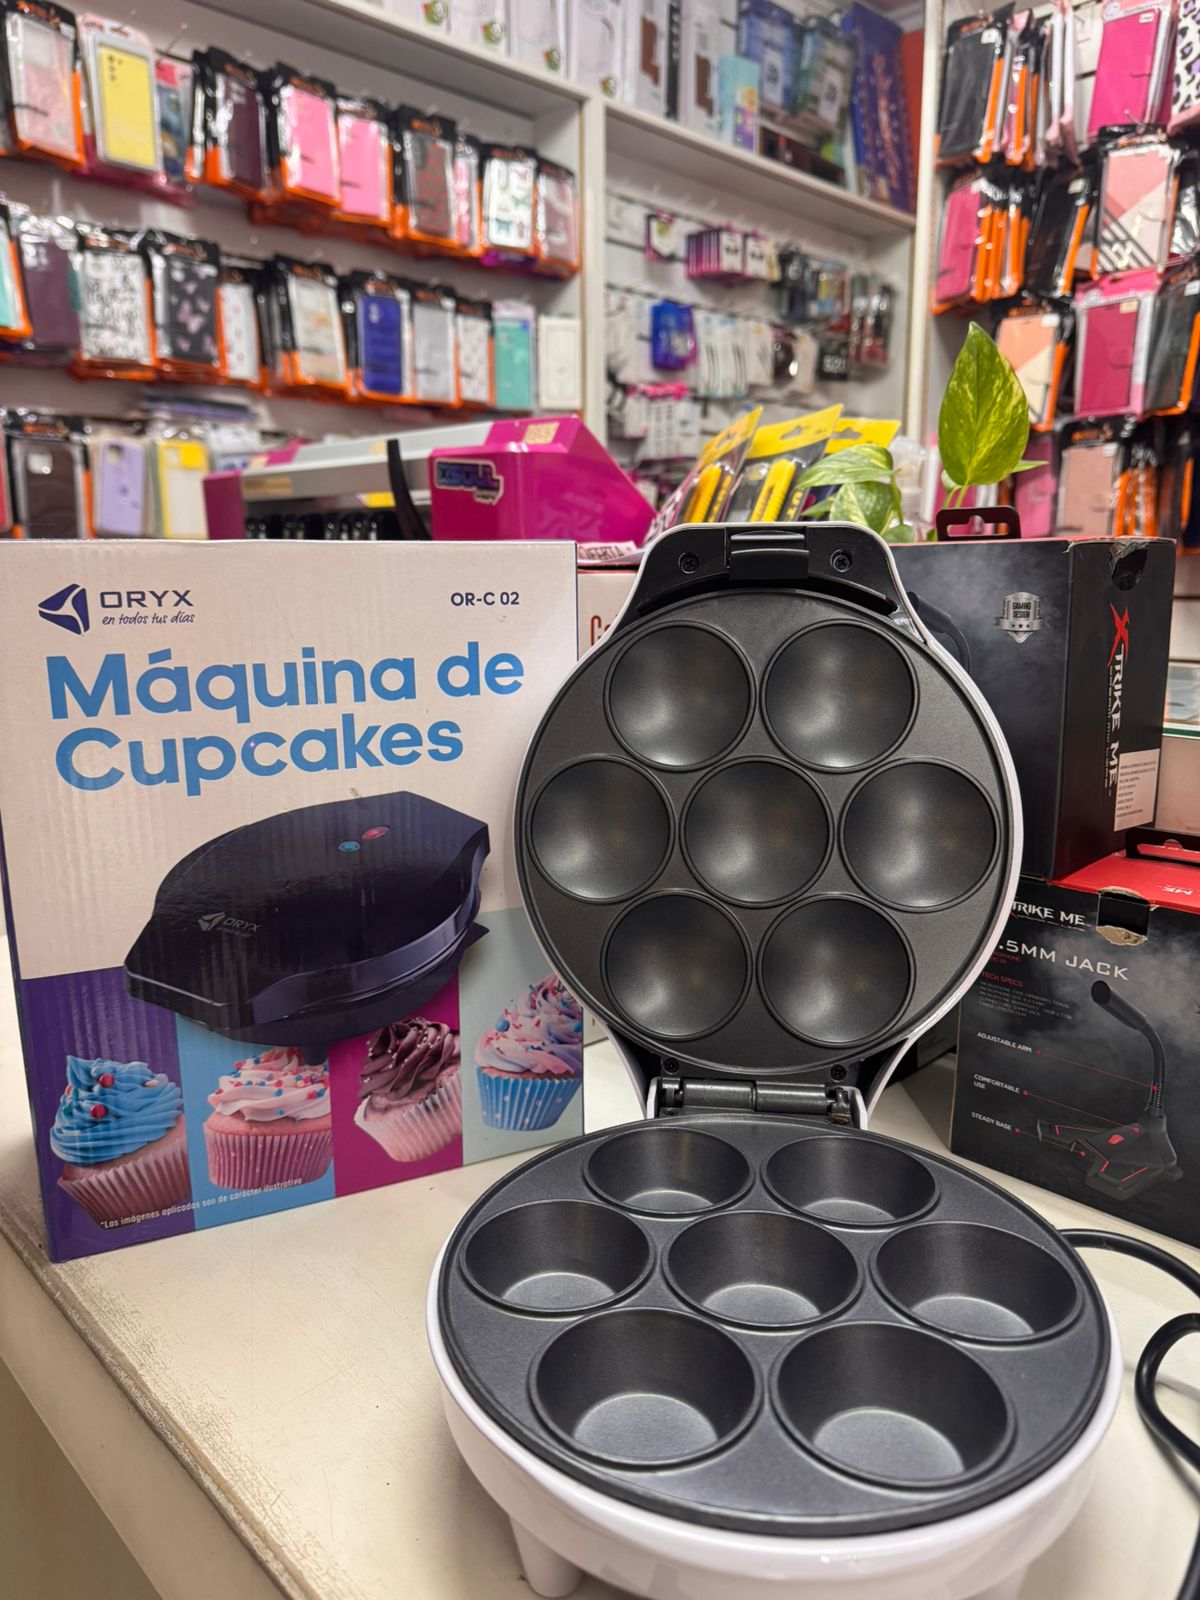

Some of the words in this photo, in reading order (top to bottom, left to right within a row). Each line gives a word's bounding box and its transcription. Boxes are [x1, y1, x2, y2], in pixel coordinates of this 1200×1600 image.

[100, 588, 194, 609] ORYX
[450, 592, 496, 607] OR-C
[499, 591, 520, 606] 02
[102, 614, 116, 625] en
[117, 612, 149, 625] todos
[151, 612, 168, 625] tus
[169, 609, 195, 624] días
[45, 646, 417, 724] Máquina
[436, 641, 524, 698] de
[55, 713, 464, 796] Cupcakes
[998, 940, 1057, 964] .5MM
[1065, 954, 1129, 981] JACK
[977, 1032, 1017, 1049] ADJUSTABLE
[973, 1081, 986, 1090] USE
[974, 1074, 1020, 1094] COMFORTABLE
[971, 1112, 995, 1125] STEADY
[120, 1210, 161, 1226] imágenes
[162, 1201, 201, 1217] aplicadas
[202, 1198, 217, 1208] son
[217, 1194, 229, 1203] de
